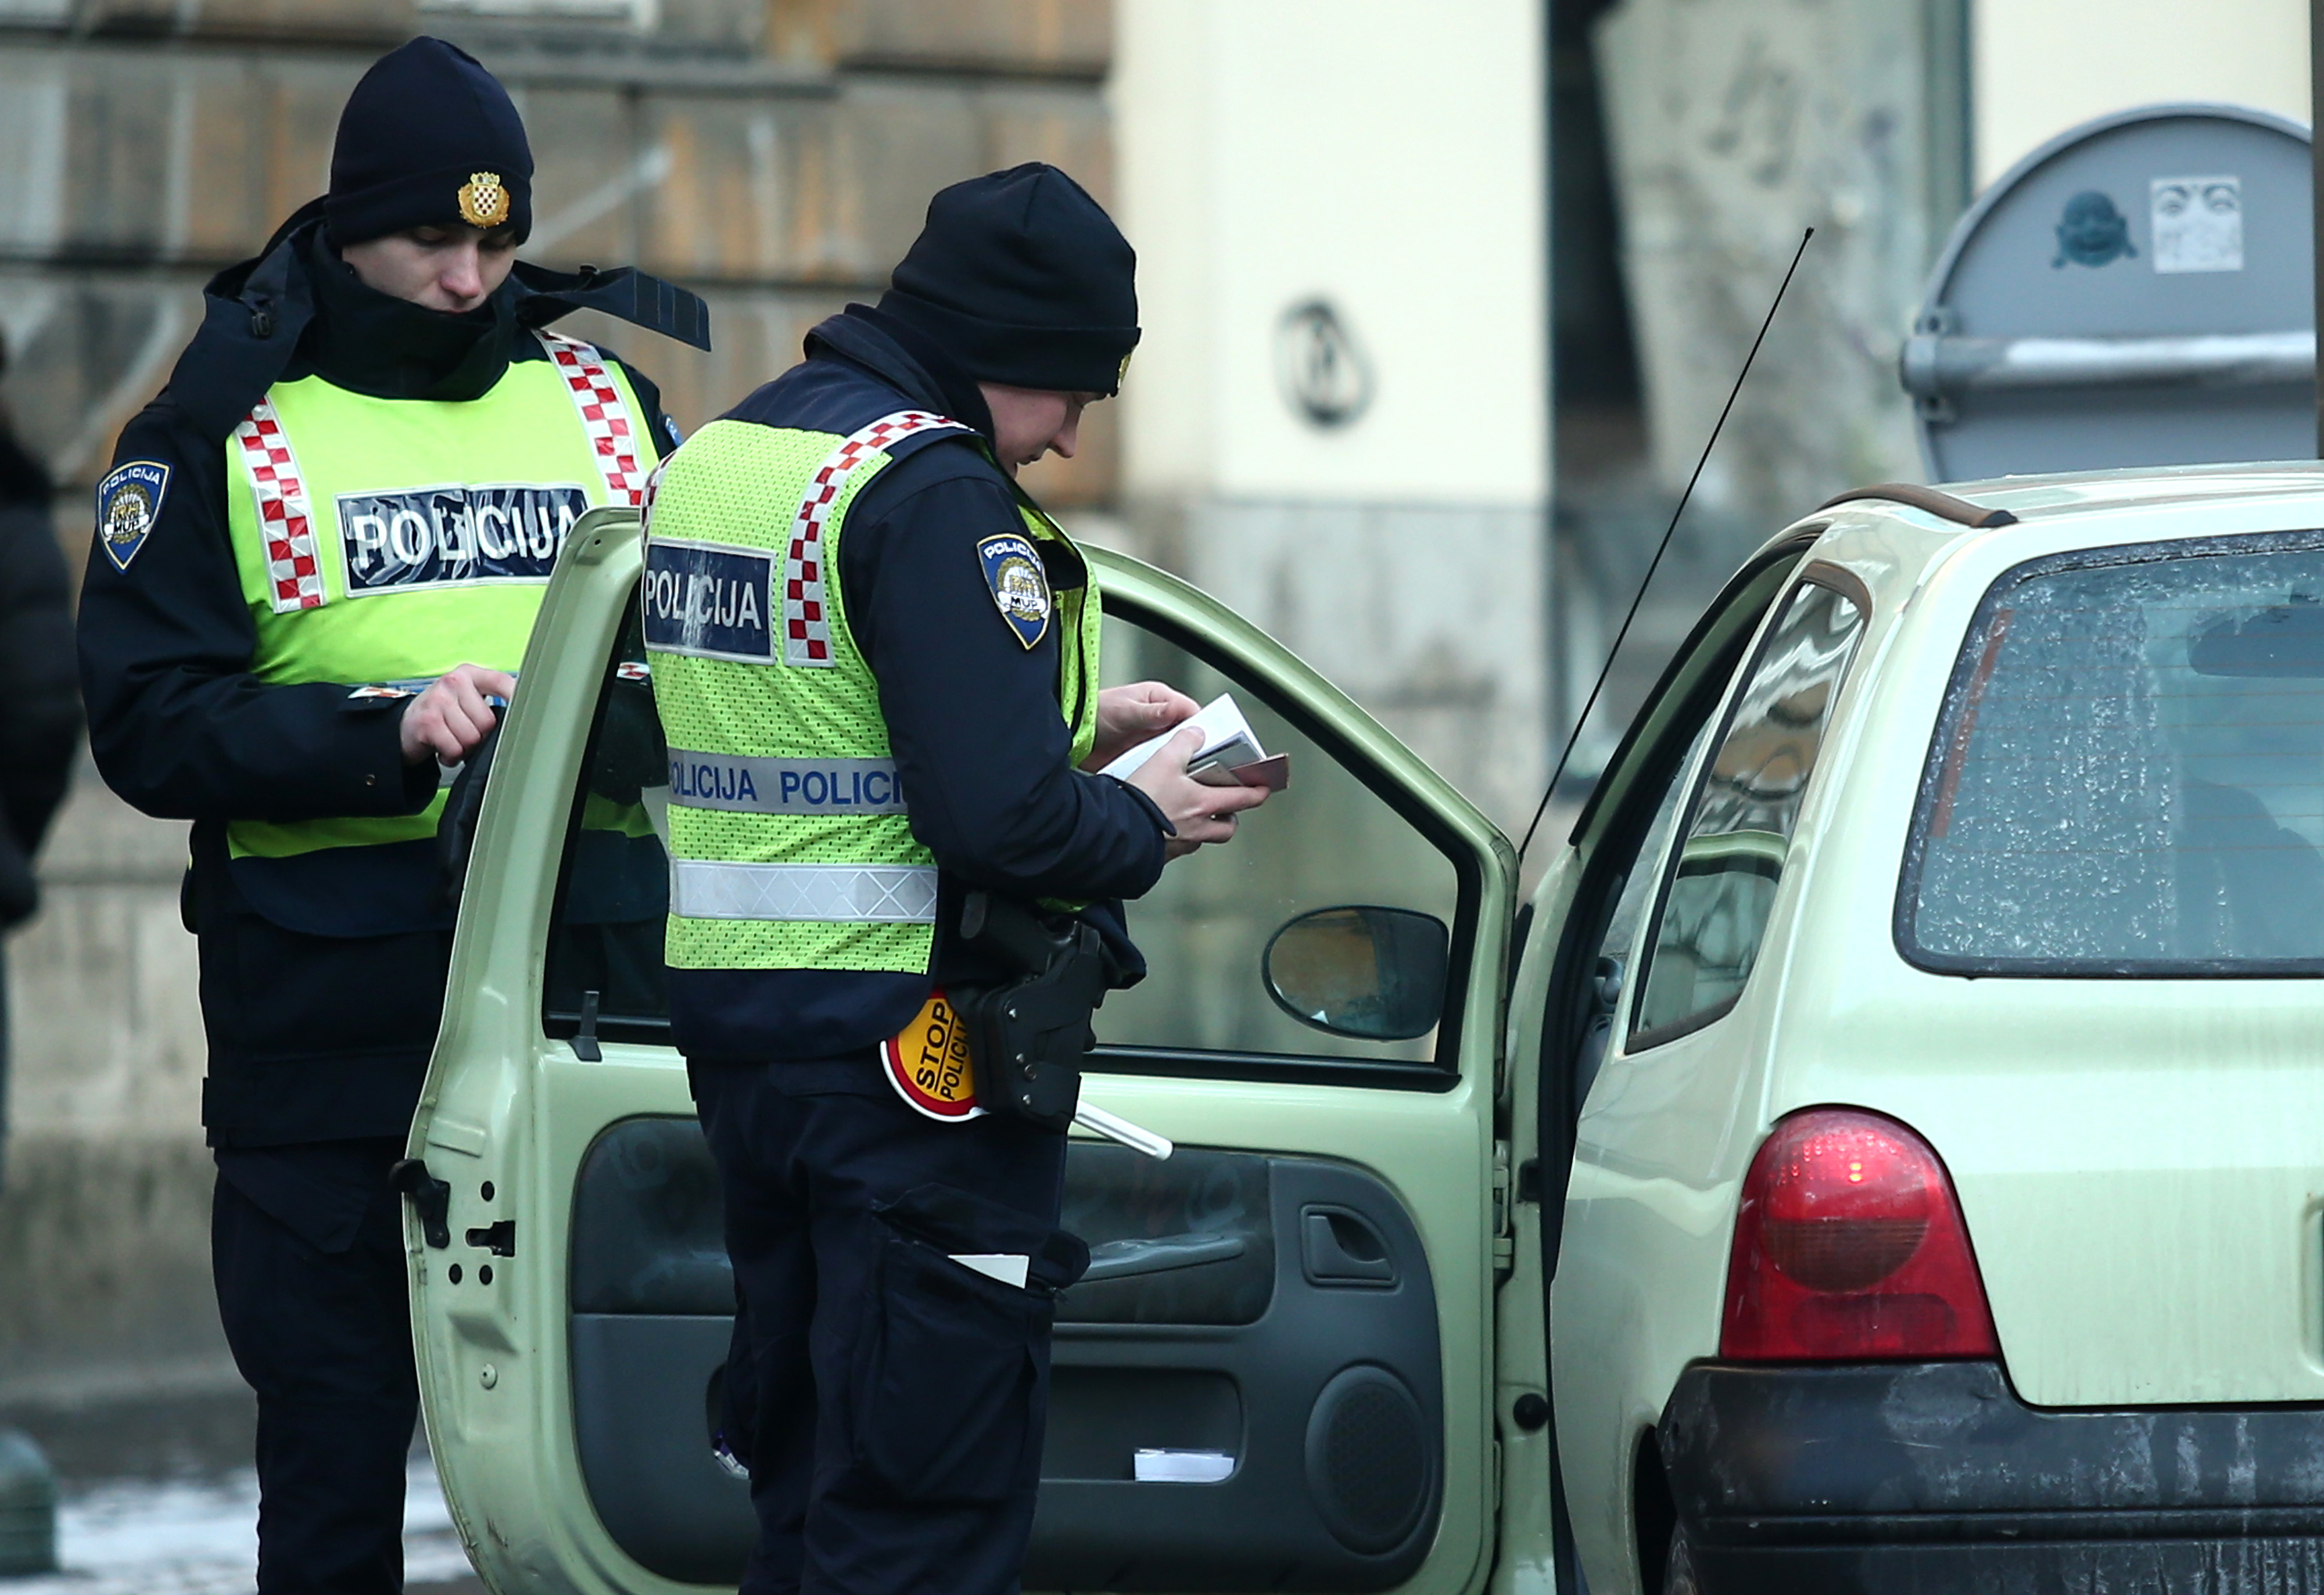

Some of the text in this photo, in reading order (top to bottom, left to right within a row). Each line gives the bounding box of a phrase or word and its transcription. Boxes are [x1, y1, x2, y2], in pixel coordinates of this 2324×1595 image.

[103, 467, 160, 494] POLICIJA
[114, 519, 139, 531] MUP
[645, 569, 762, 630] POLICIJA
[1011, 595, 1038, 609] MUP
[670, 761, 758, 802] OLICIJA
[916, 1002, 949, 1089] STOP
[940, 1025, 969, 1101] POLICIJ
